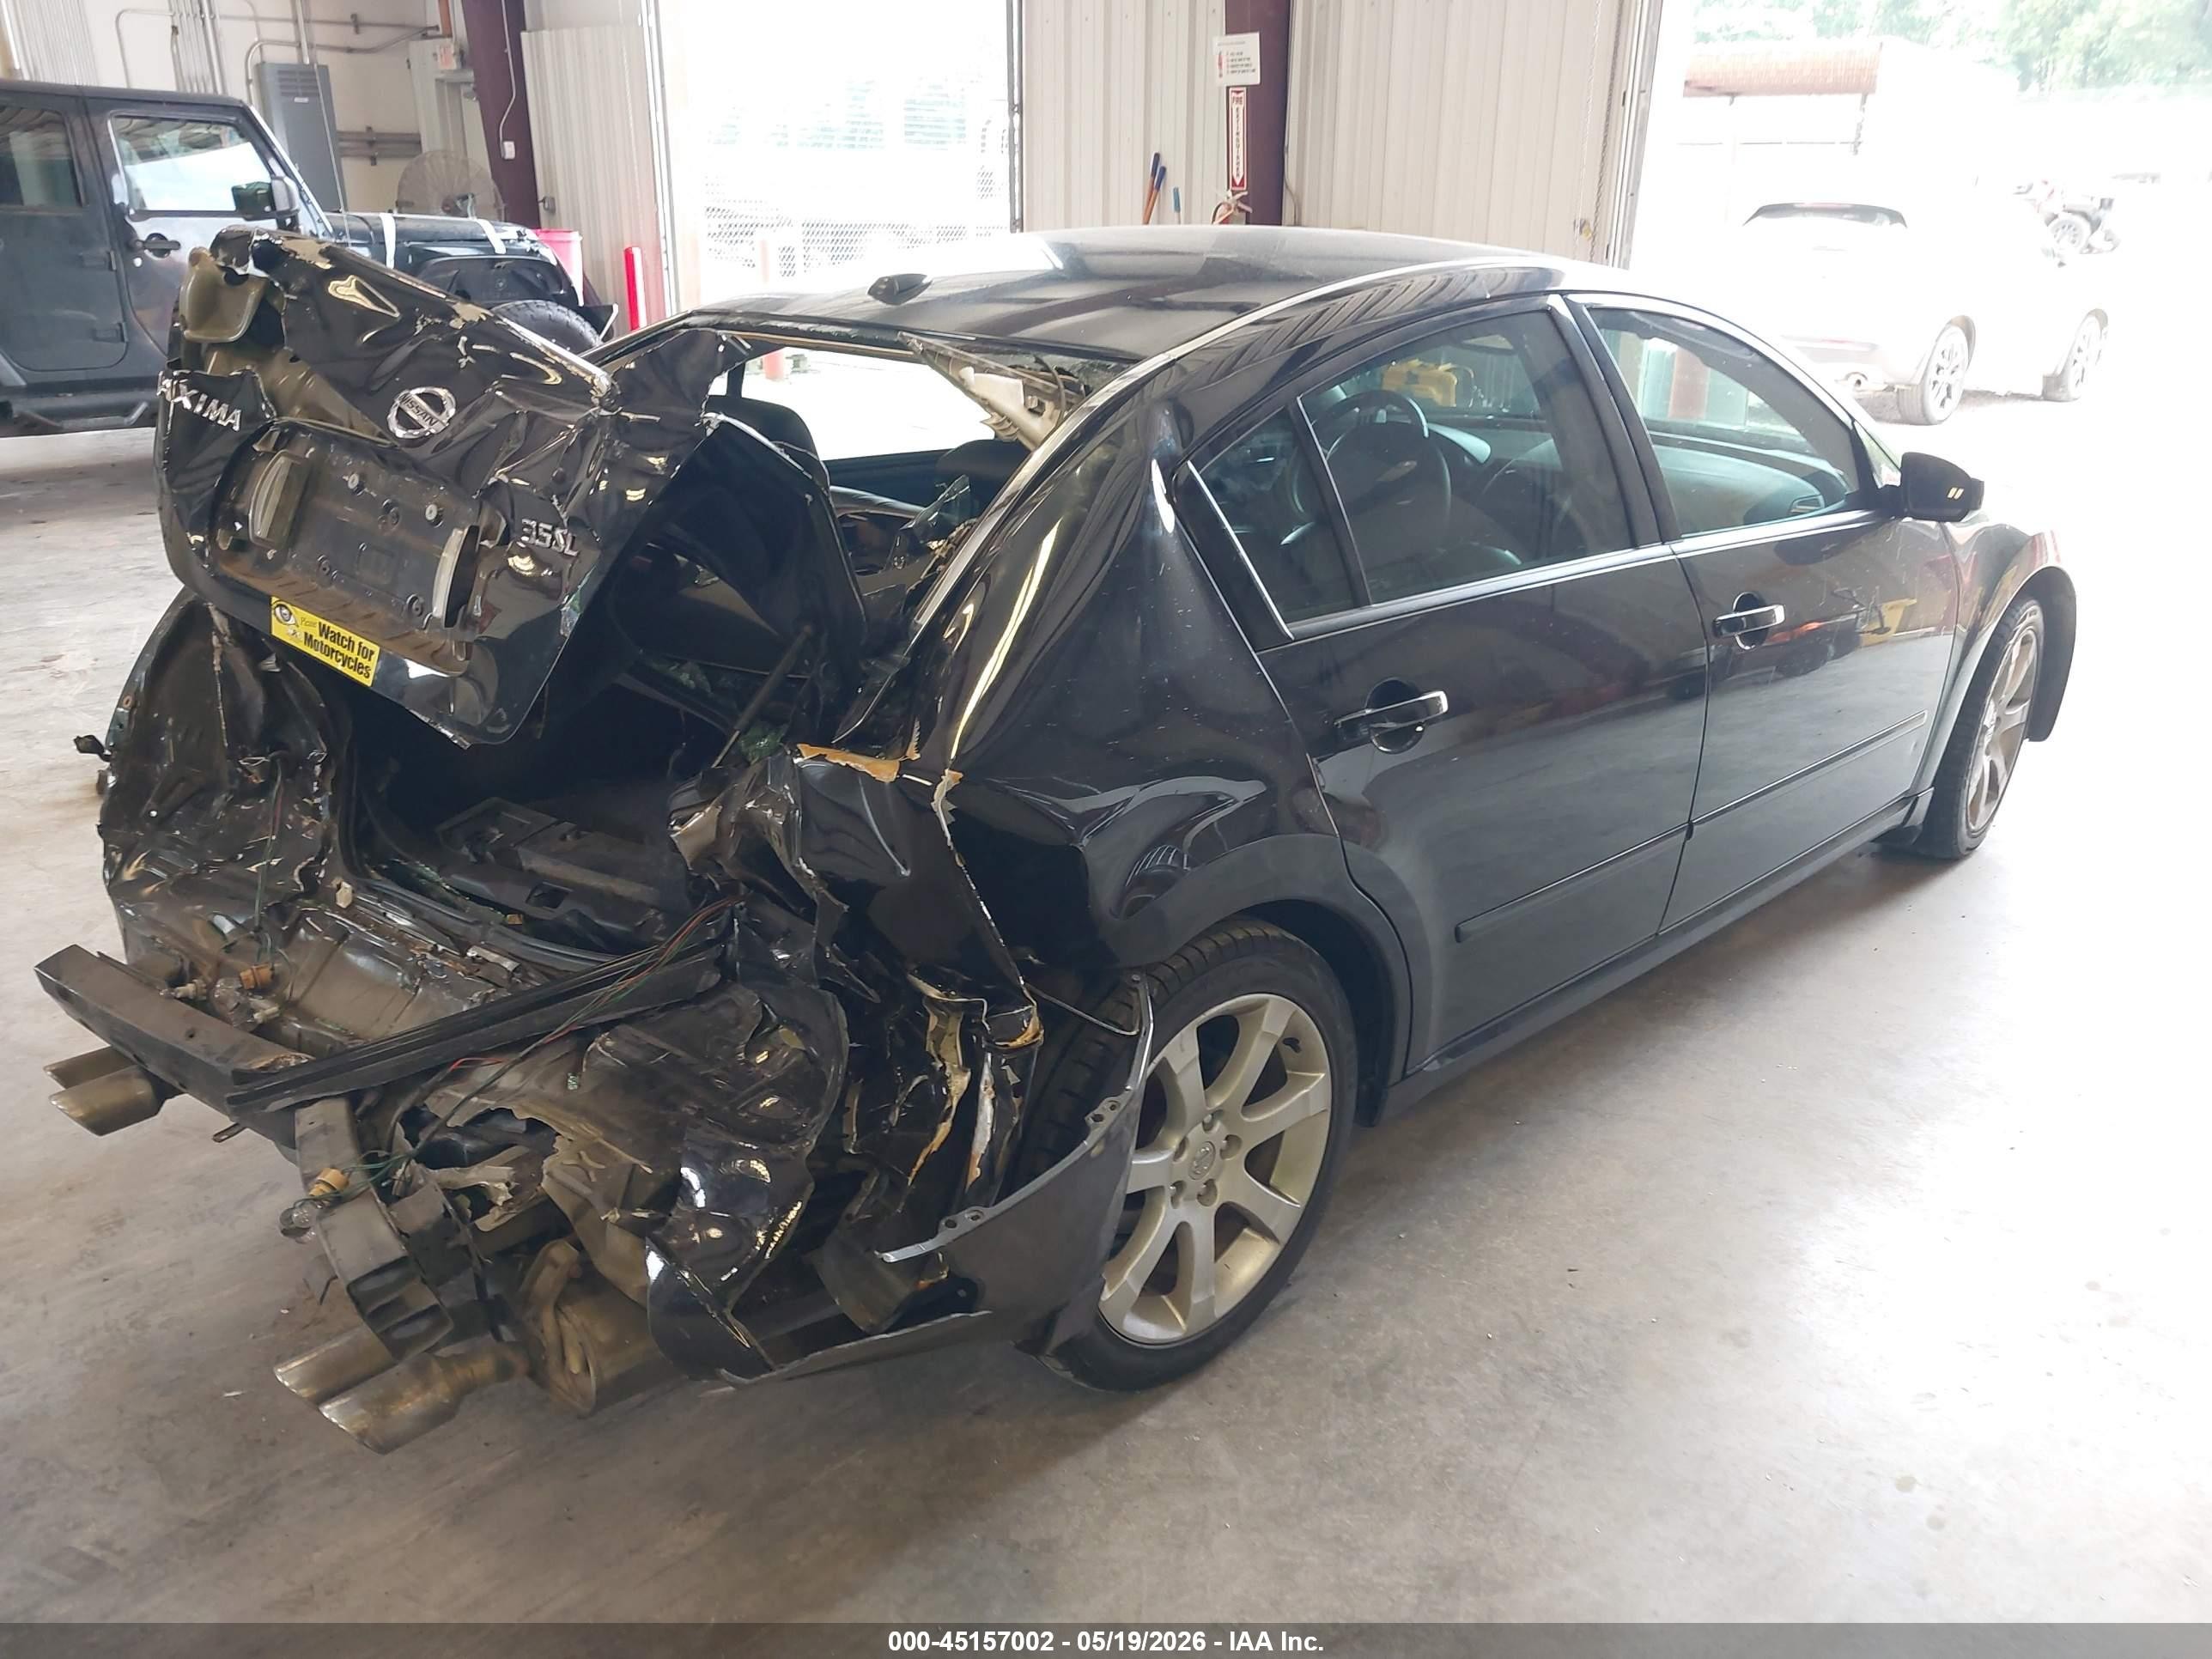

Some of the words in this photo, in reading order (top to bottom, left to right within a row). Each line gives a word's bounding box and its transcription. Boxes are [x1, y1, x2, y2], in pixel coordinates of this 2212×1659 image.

[398, 395, 440, 427] NISSAN
[304, 632, 372, 678] Motorcycles
[319, 622, 355, 653] Watch
[357, 641, 375, 661] for
